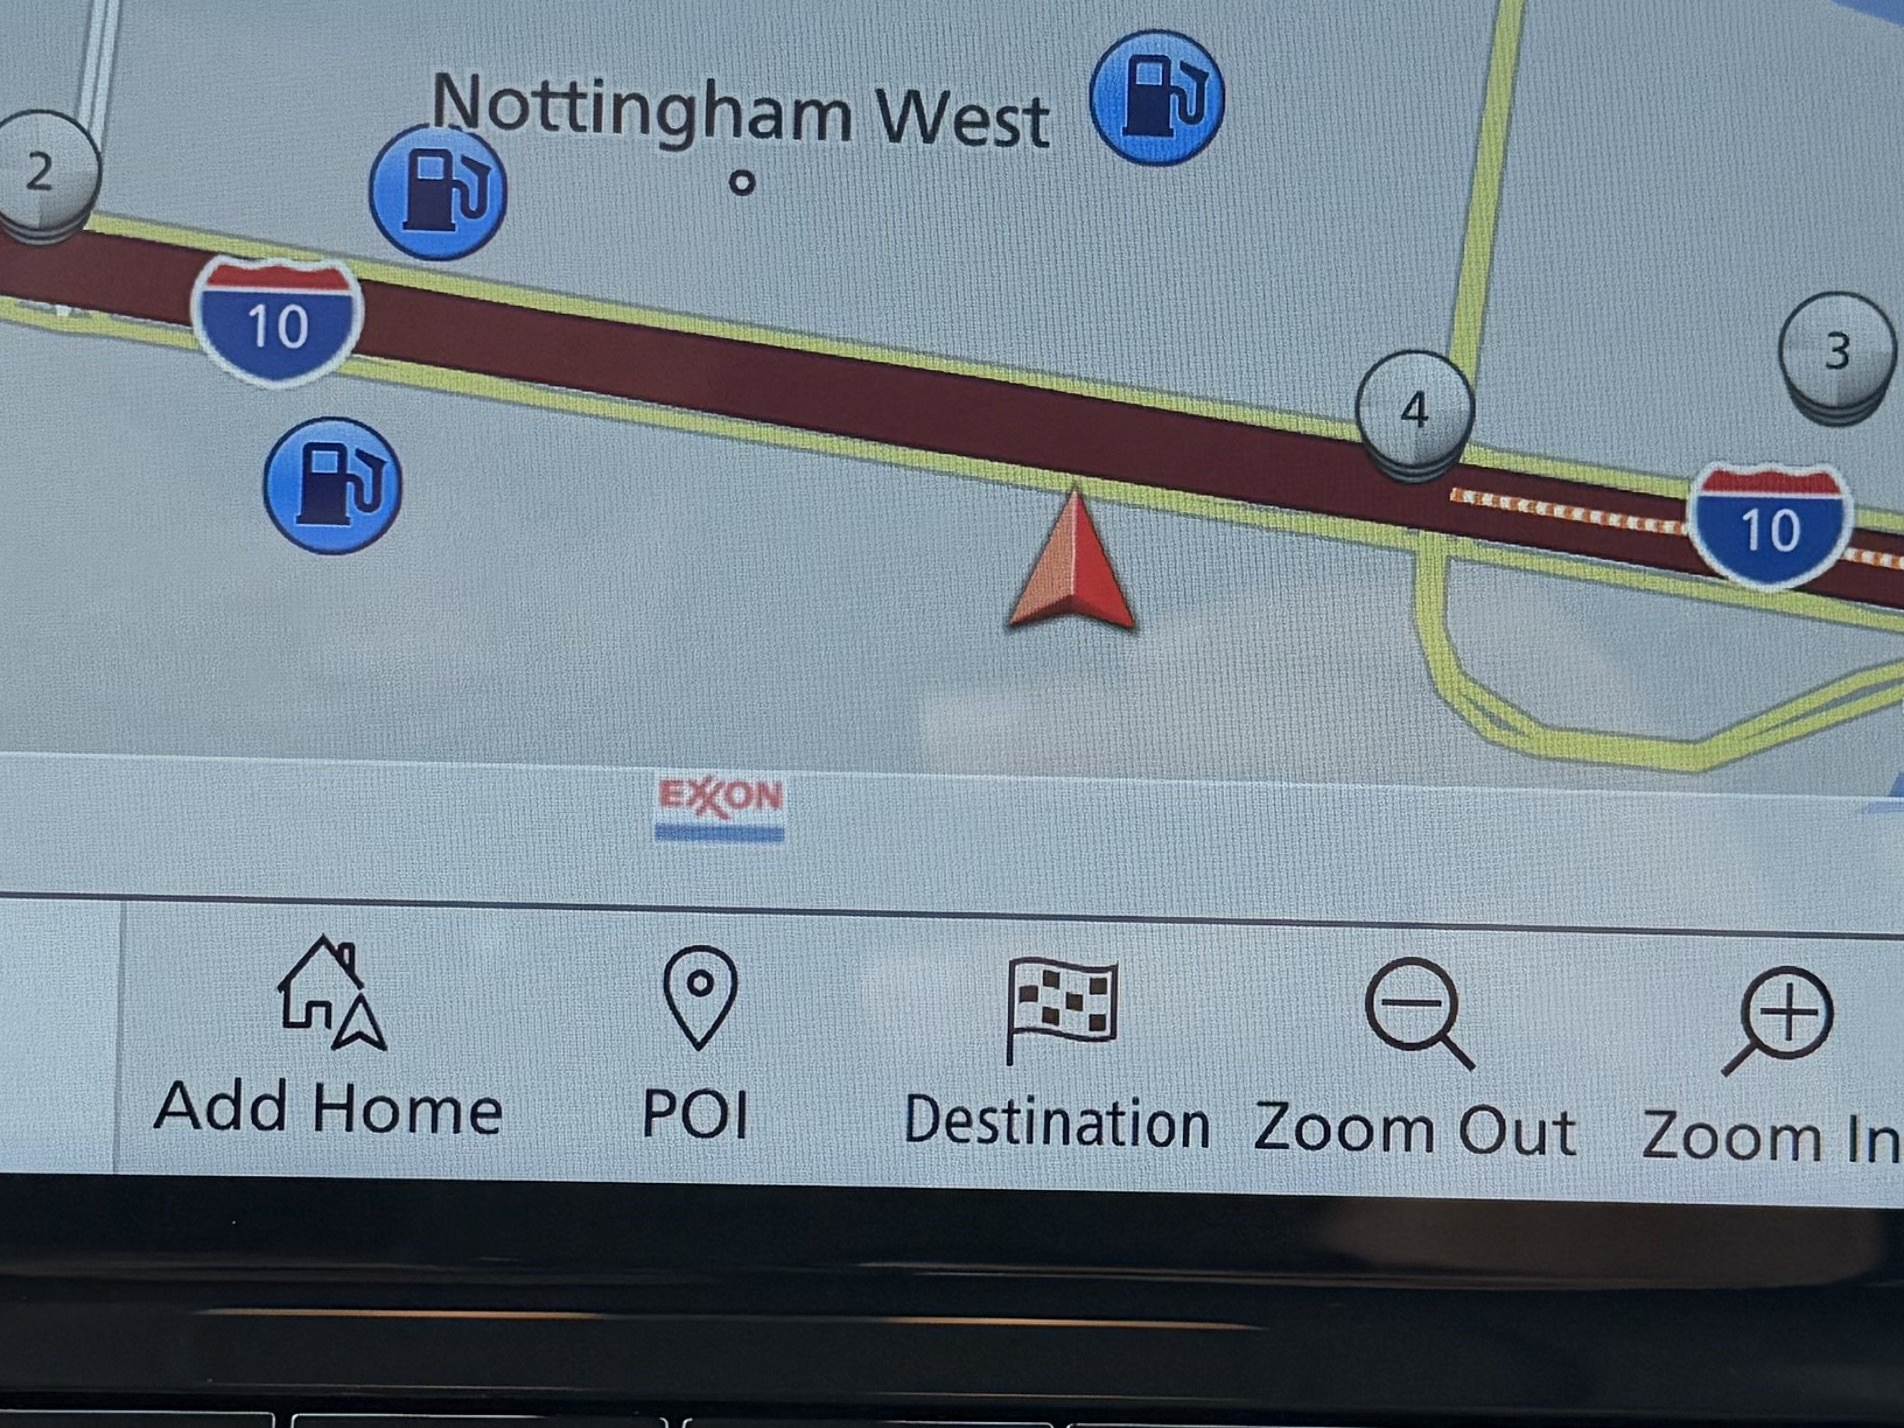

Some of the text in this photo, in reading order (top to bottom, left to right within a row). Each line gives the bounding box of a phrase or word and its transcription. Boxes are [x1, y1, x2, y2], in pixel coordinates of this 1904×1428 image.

[433, 72, 1050, 151] Nottingham West
[27, 151, 52, 191] 2
[249, 304, 307, 348] 10
[1826, 332, 1849, 370] 3
[1401, 391, 1429, 428] 4
[1743, 509, 1800, 551] 10
[660, 775, 781, 820] EXXON
[153, 1077, 502, 1135] Add Home
[645, 1088, 746, 1139] POI
[906, 1094, 1209, 1148] Destination
[1255, 1101, 1576, 1156] Zoom Out
[1643, 1110, 1900, 1163] Zoom In
